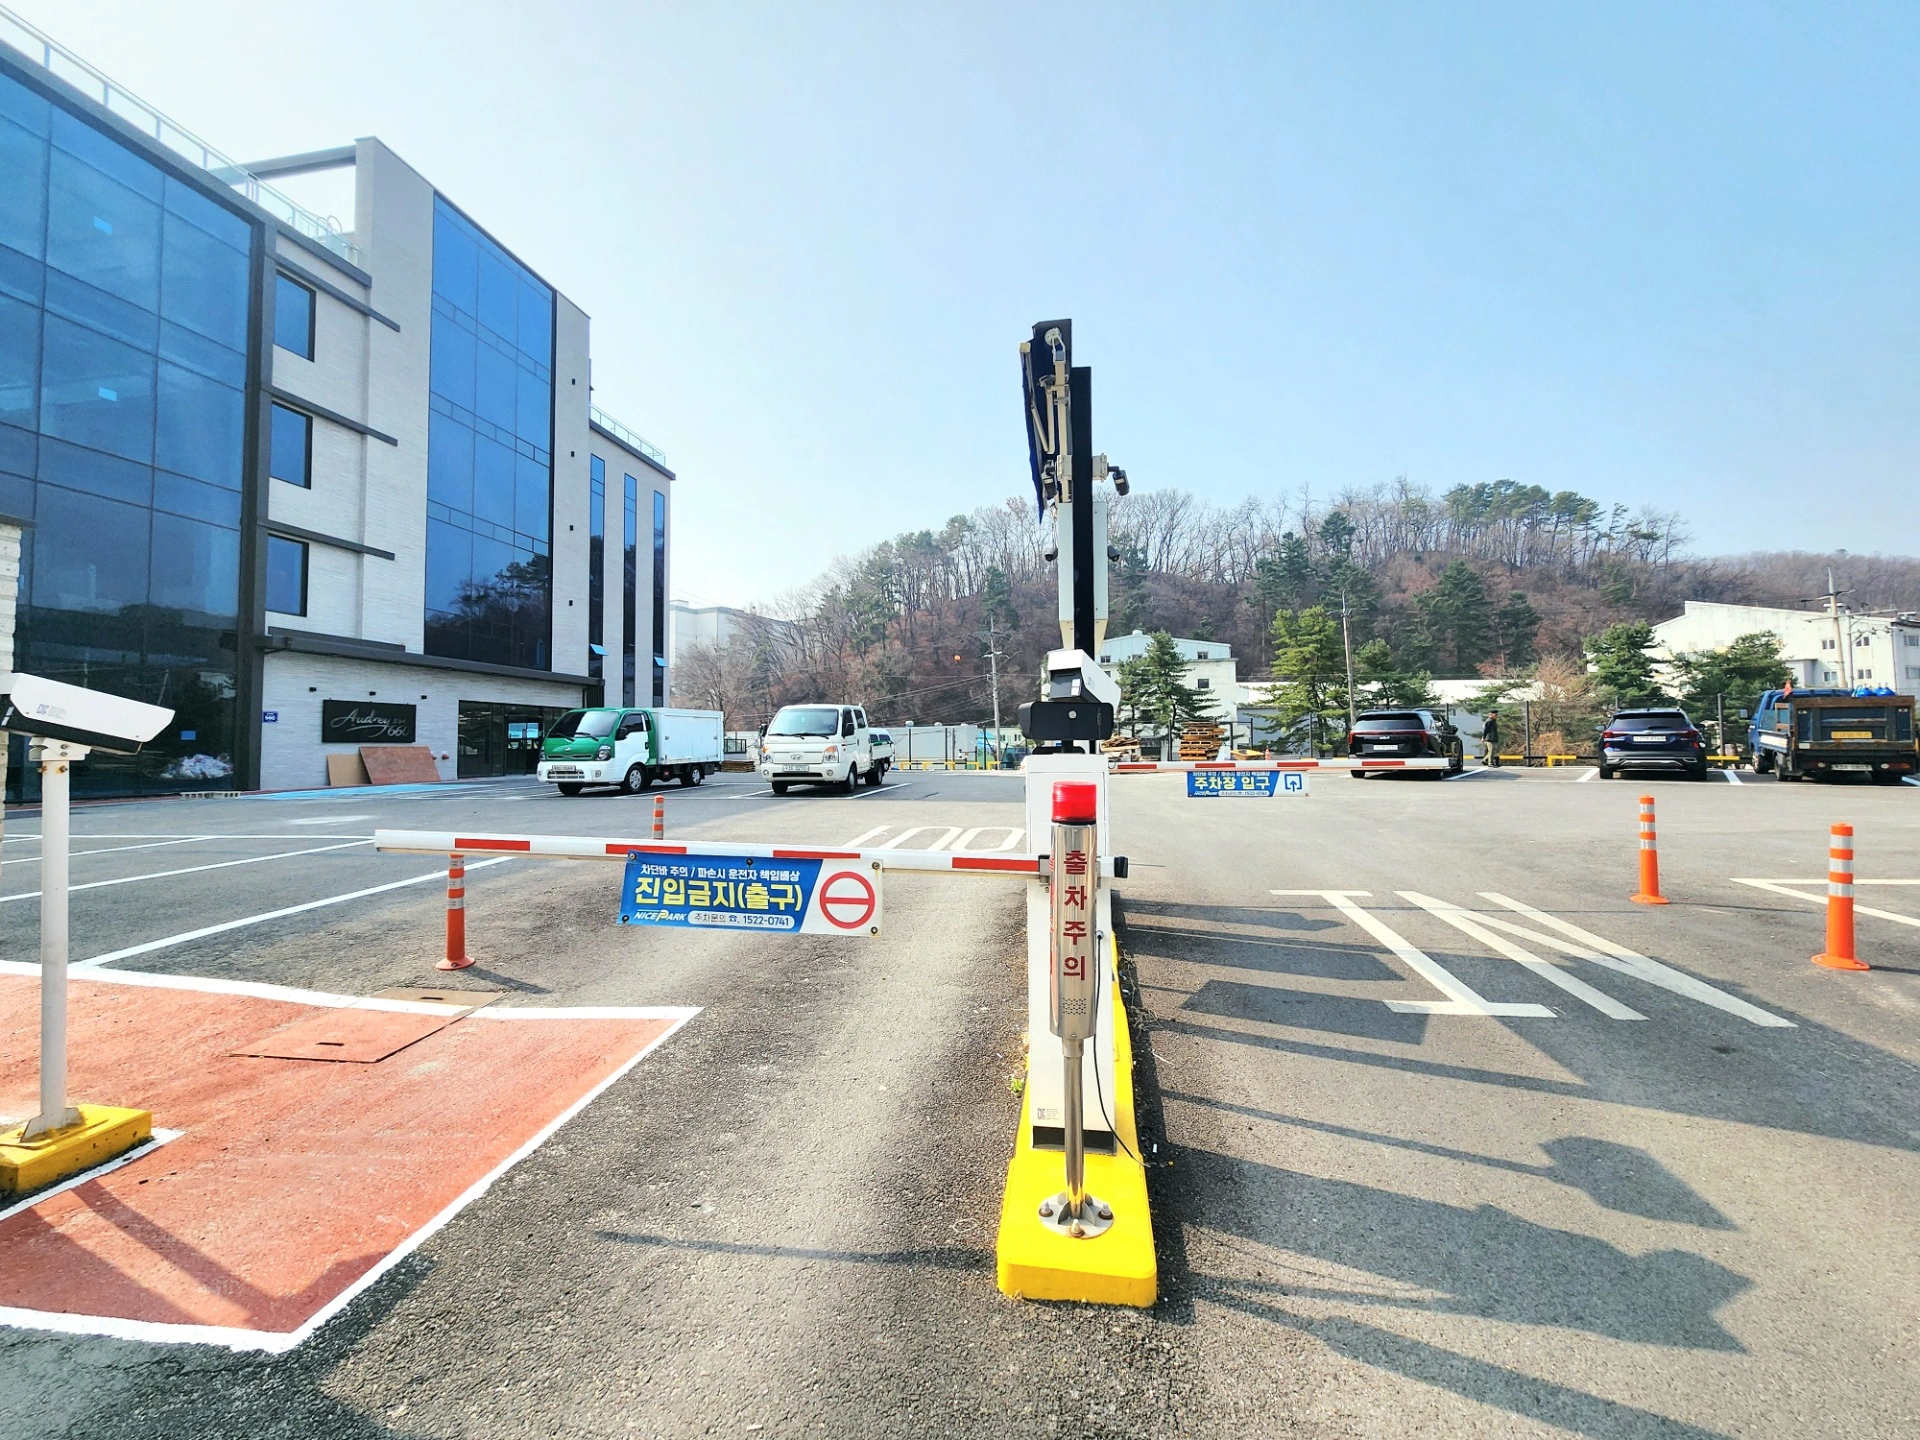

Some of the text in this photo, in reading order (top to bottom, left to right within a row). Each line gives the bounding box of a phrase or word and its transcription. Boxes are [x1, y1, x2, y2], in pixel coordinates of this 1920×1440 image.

[330, 707, 390, 738] Audrey
[1194, 776, 1270, 790] 주차장 입구
[640, 864, 668, 876] 차단바
[670, 866, 688, 877] 주의
[697, 867, 726, 879] 파손시
[728, 868, 758, 880] 운전자
[759, 869, 800, 882] 책임배상
[635, 877, 803, 911] 진입금지(출구)
[743, 915, 789, 926] 1522-0741
[1270, 890, 1799, 1028] IN
